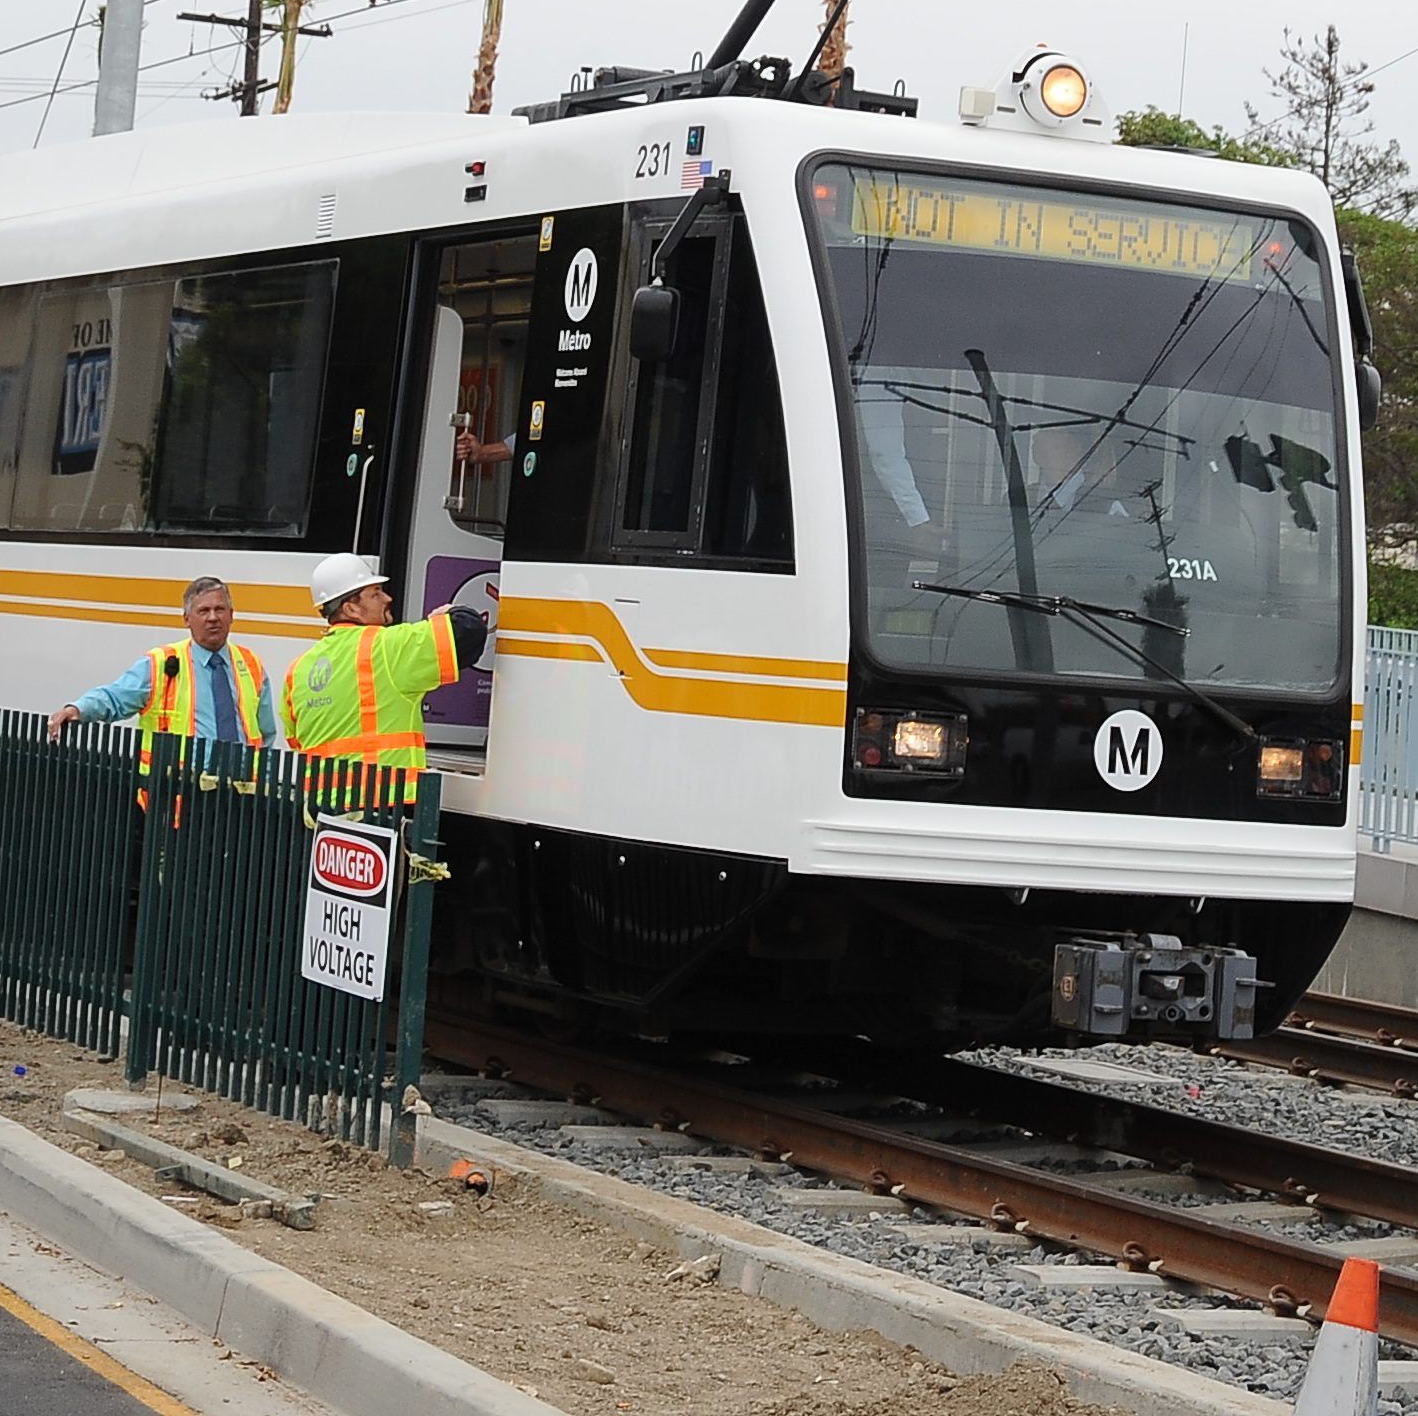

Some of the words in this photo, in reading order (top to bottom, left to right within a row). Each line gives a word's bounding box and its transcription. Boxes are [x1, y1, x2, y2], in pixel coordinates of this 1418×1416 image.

[636, 142, 671, 178] 231
[885, 186, 966, 240] NOT
[994, 199, 1045, 252] IN
[1068, 210, 1242, 274] SERVICE
[570, 262, 593, 308] M
[558, 330, 591, 352] Metro
[1167, 557, 1218, 582] 231A
[1107, 725, 1151, 776] M
[319, 841, 376, 885] DANGER
[322, 900, 362, 941] HIGH
[309, 936, 375, 987] VOLTAGE
